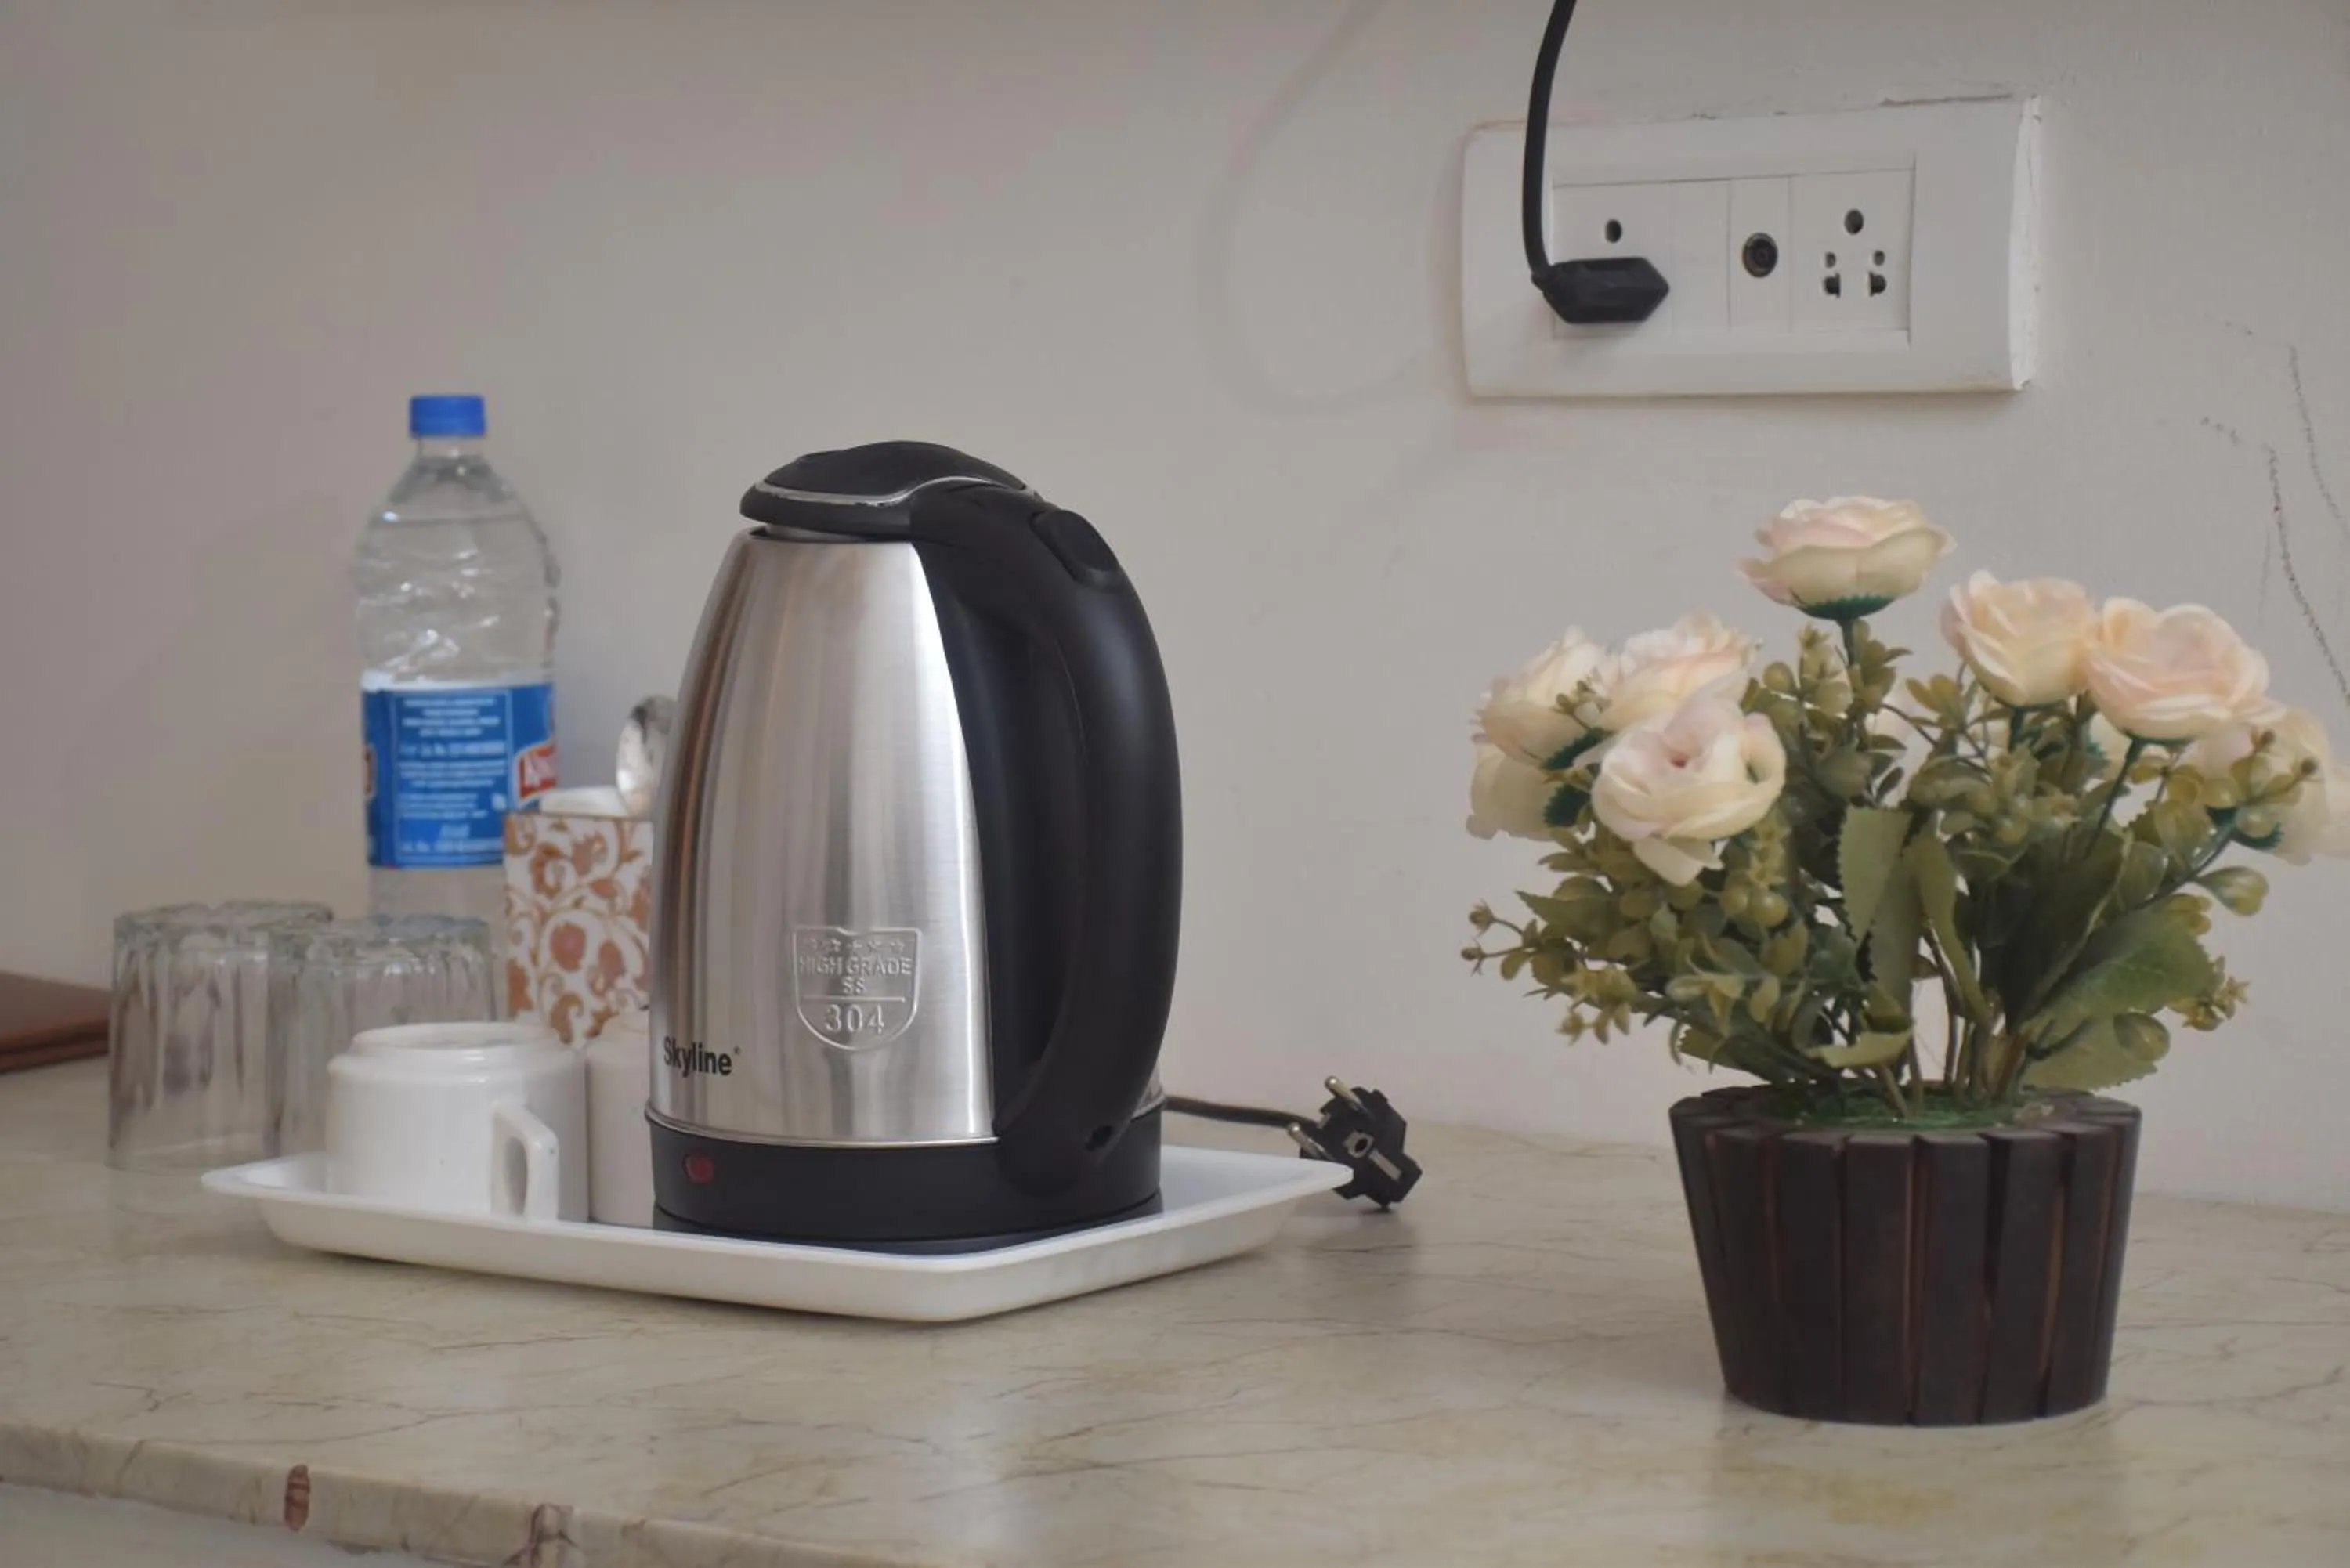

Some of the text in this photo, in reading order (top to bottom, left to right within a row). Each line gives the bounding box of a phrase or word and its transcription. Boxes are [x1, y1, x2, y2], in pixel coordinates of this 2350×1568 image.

[800, 956, 912, 976] HIGH GRADE
[843, 977, 866, 994] SS
[826, 1004, 884, 1033] 304
[664, 1036, 732, 1078] Skyline
